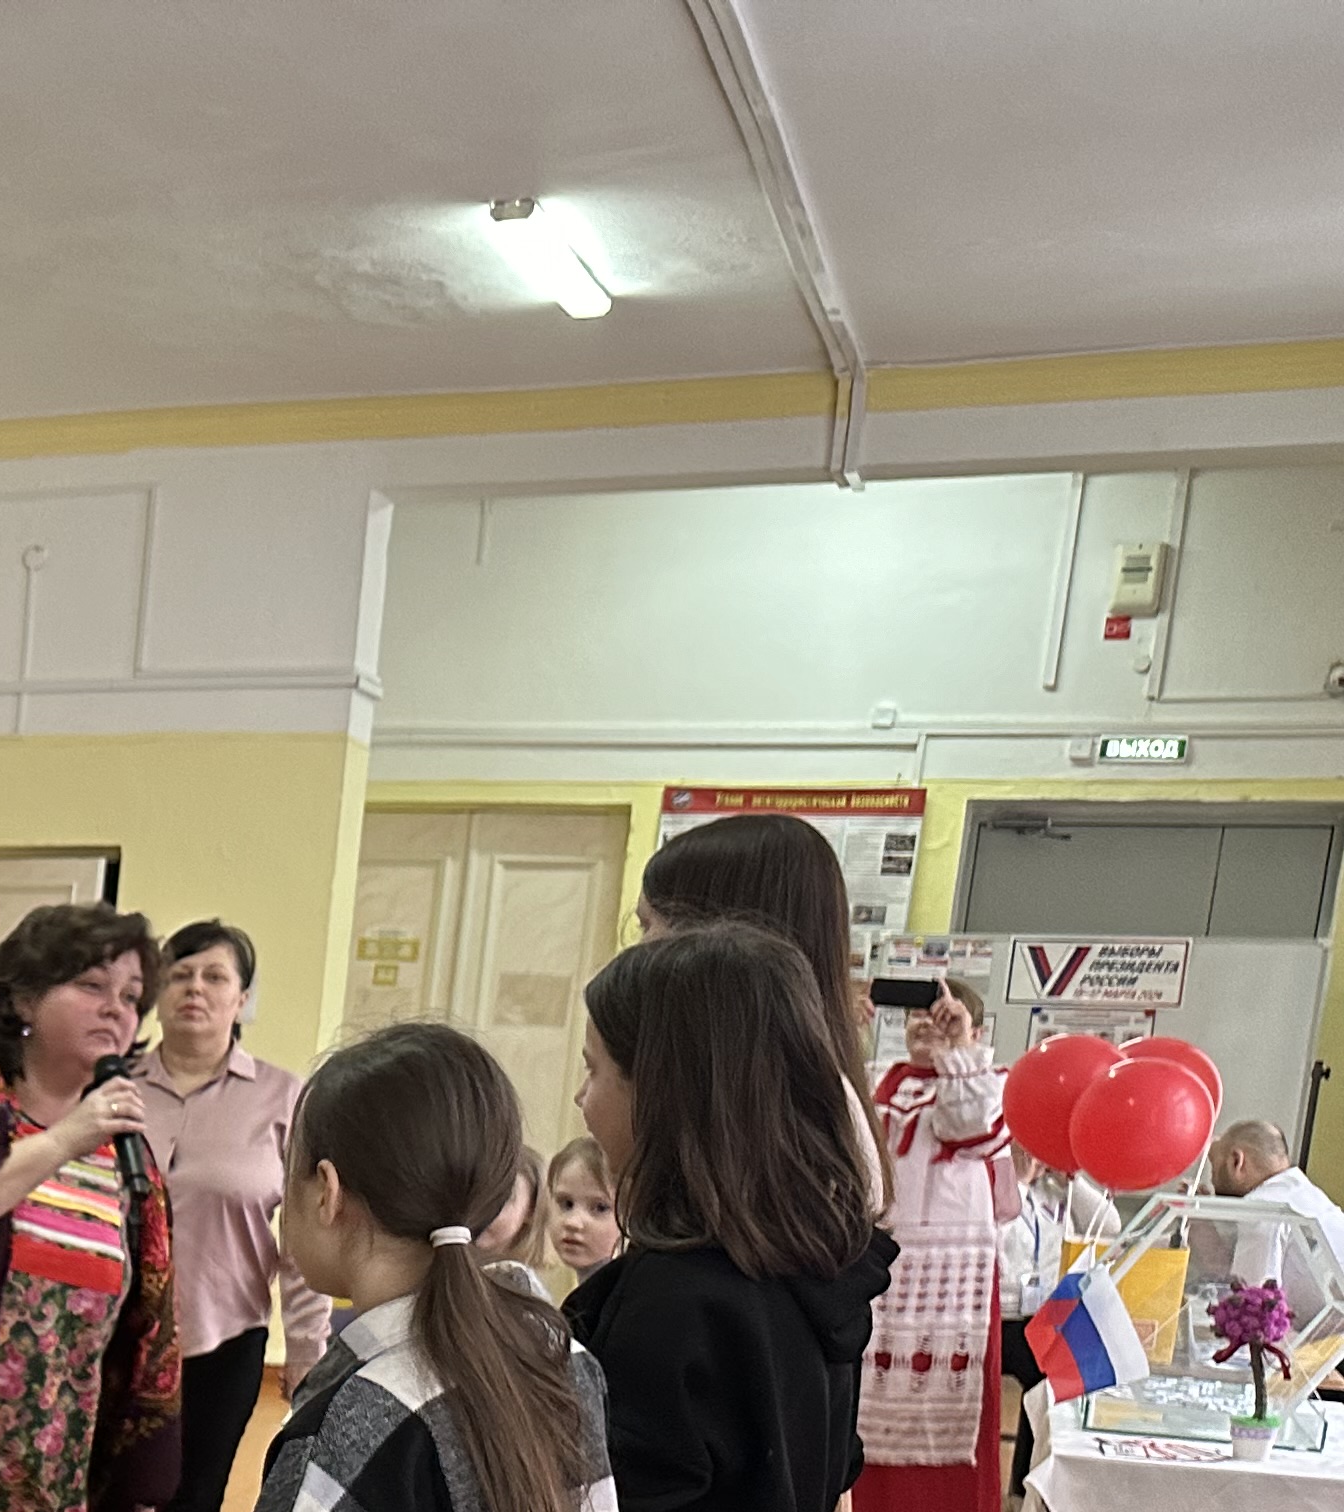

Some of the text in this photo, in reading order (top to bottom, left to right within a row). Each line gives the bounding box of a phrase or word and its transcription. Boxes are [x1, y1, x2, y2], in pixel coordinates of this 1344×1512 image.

[1105, 739, 1179, 758] ВЫХОД
[1098, 945, 1164, 958] ВЫБОРЫ
[1089, 960, 1180, 974] ПРЕЗИДЕНТА
[1079, 973, 1139, 987] РОССИИ
